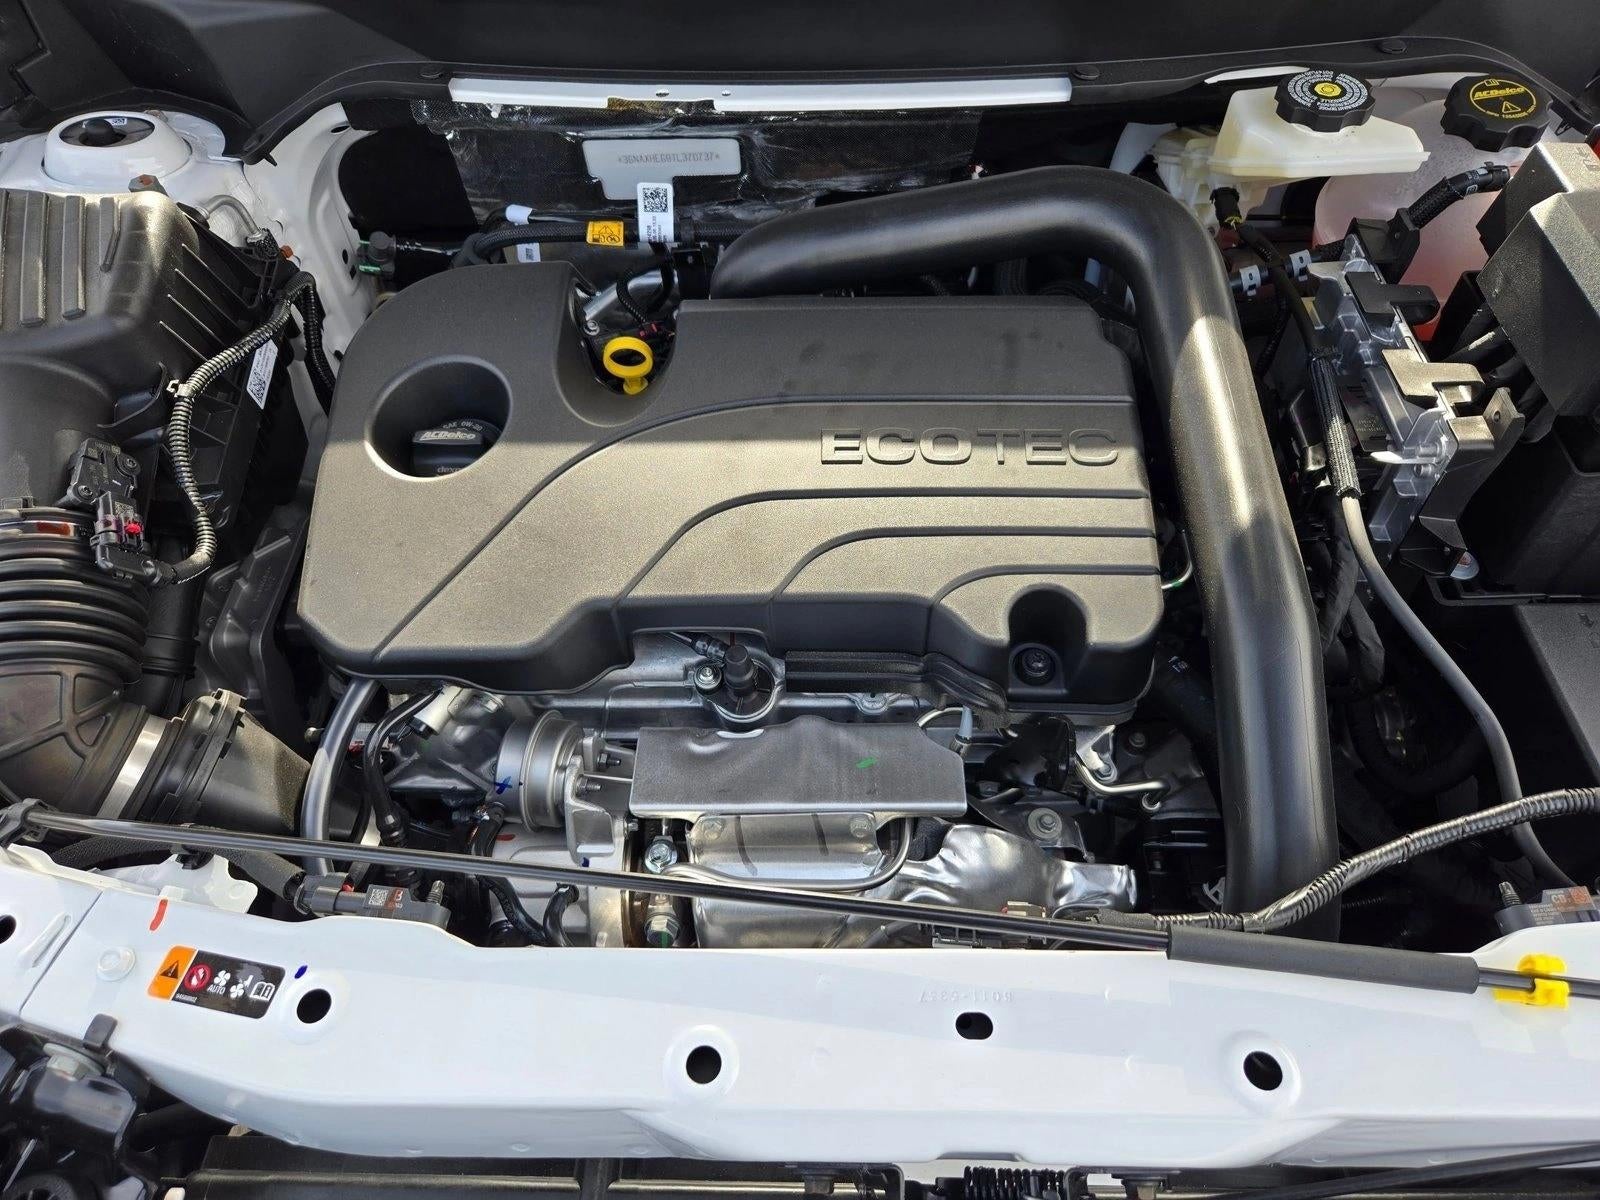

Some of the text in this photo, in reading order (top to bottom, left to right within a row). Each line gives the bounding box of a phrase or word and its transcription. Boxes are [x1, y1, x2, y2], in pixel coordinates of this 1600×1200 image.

[1474, 87, 1526, 100] ACDelco
[420, 431, 476, 441] ACDelco
[821, 427, 1119, 466] ECOTEC
[207, 984, 226, 995] AUTO
